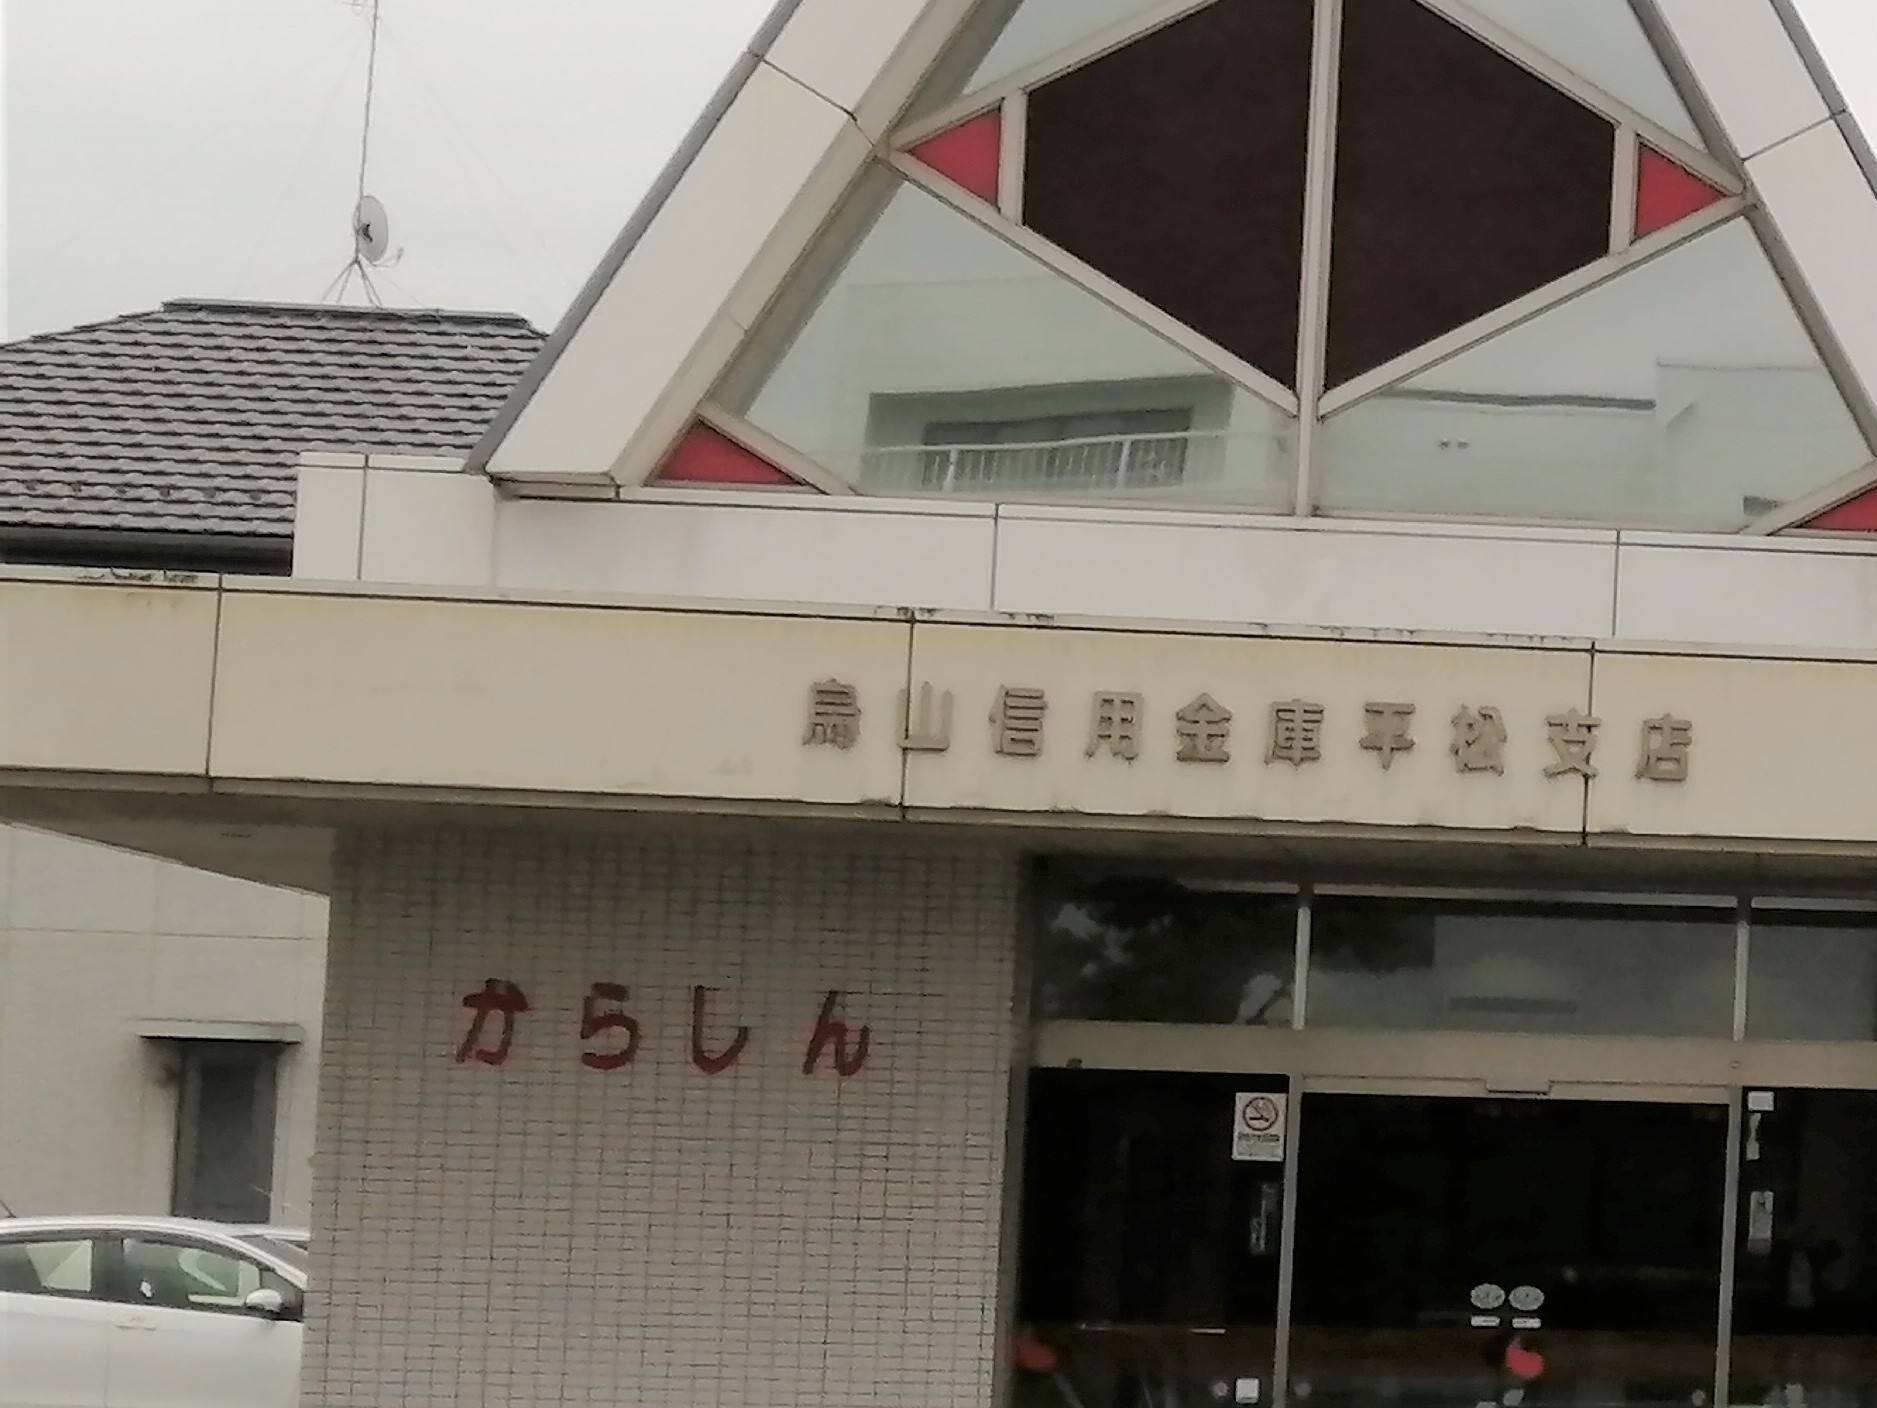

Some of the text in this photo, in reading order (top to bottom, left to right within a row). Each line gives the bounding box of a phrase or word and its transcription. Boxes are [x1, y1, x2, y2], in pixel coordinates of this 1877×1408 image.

[801, 677, 1694, 783] 烏山信用金庫平松支店
[455, 977, 872, 1078] からしん
